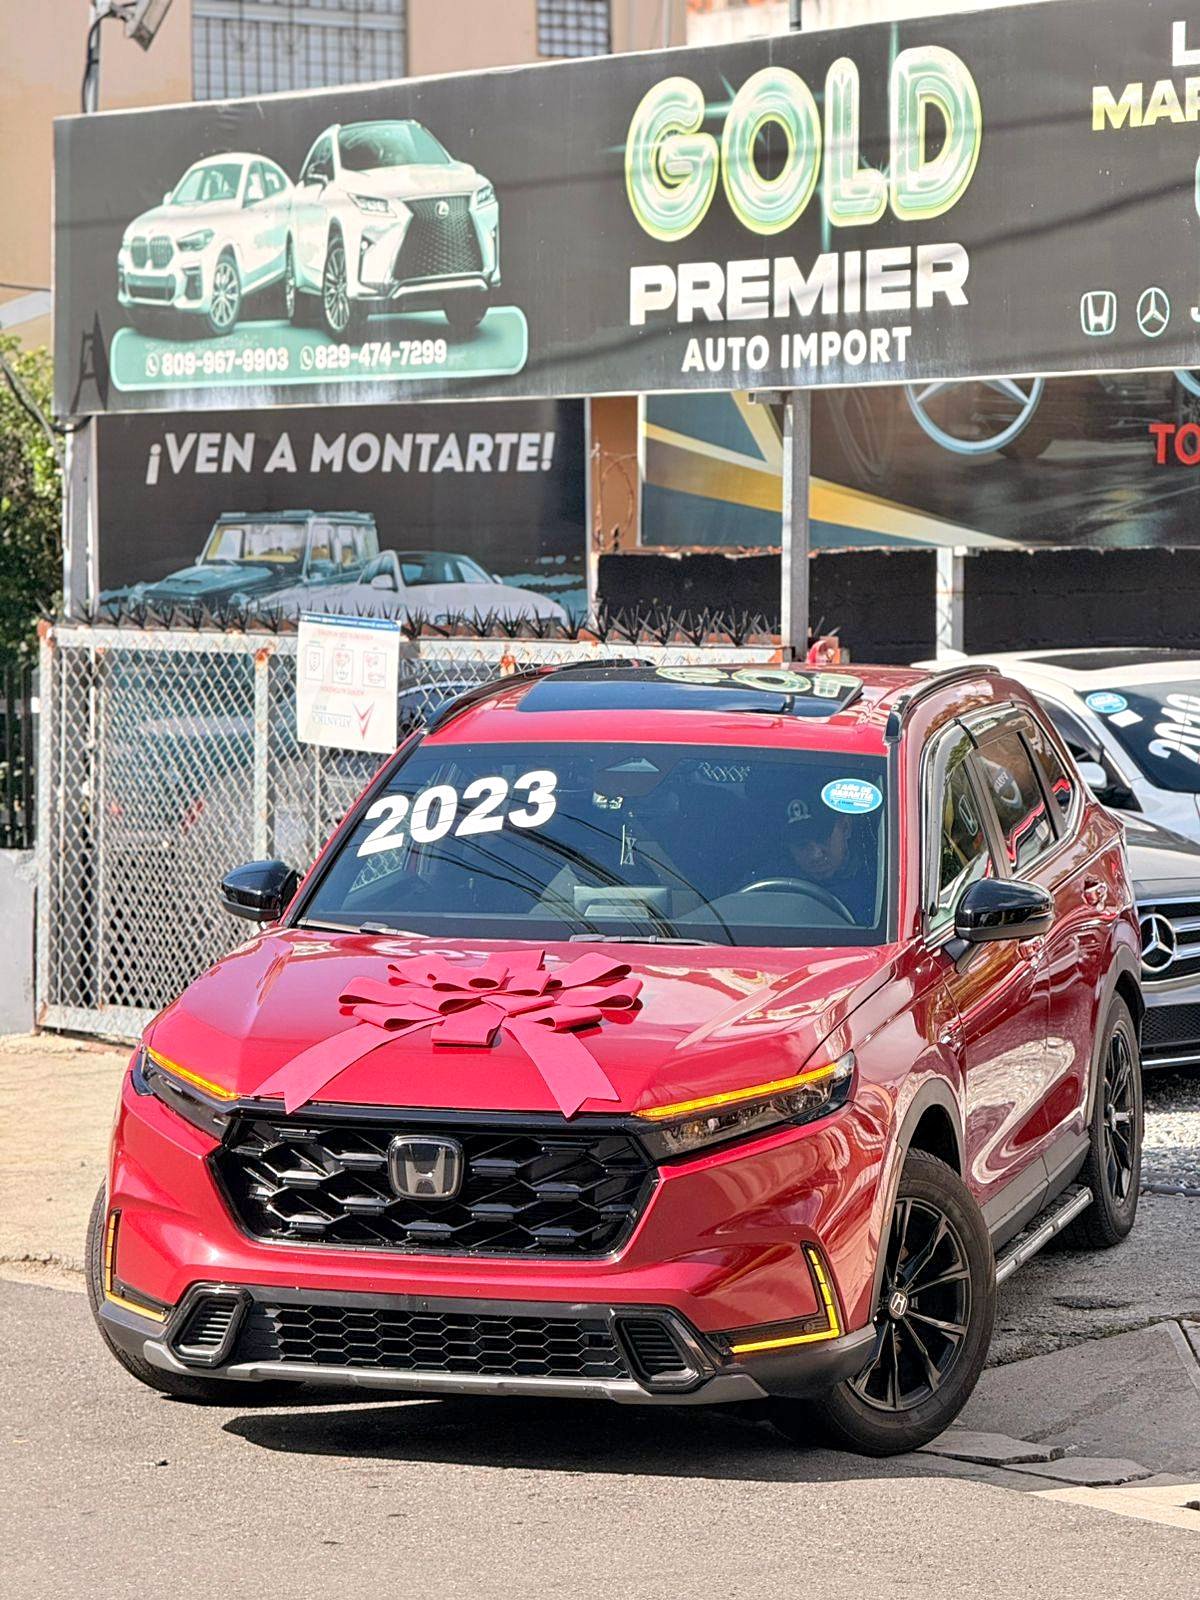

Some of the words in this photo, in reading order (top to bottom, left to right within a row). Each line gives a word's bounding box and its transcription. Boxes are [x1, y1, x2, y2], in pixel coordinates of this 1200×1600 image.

[625, 45, 982, 242] GOLD
[630, 242, 970, 326] PREMIER
[161, 347, 289, 376] 809-967-9903
[315, 339, 447, 369] 829-474-7299
[681, 335, 770, 372] AUTO
[780, 326, 911, 369] IMPORT
[146, 432, 255, 485] ¡VEN
[263, 432, 297, 473] A
[310, 432, 555, 473] MONTARTE!
[357, 770, 558, 858] 2023
